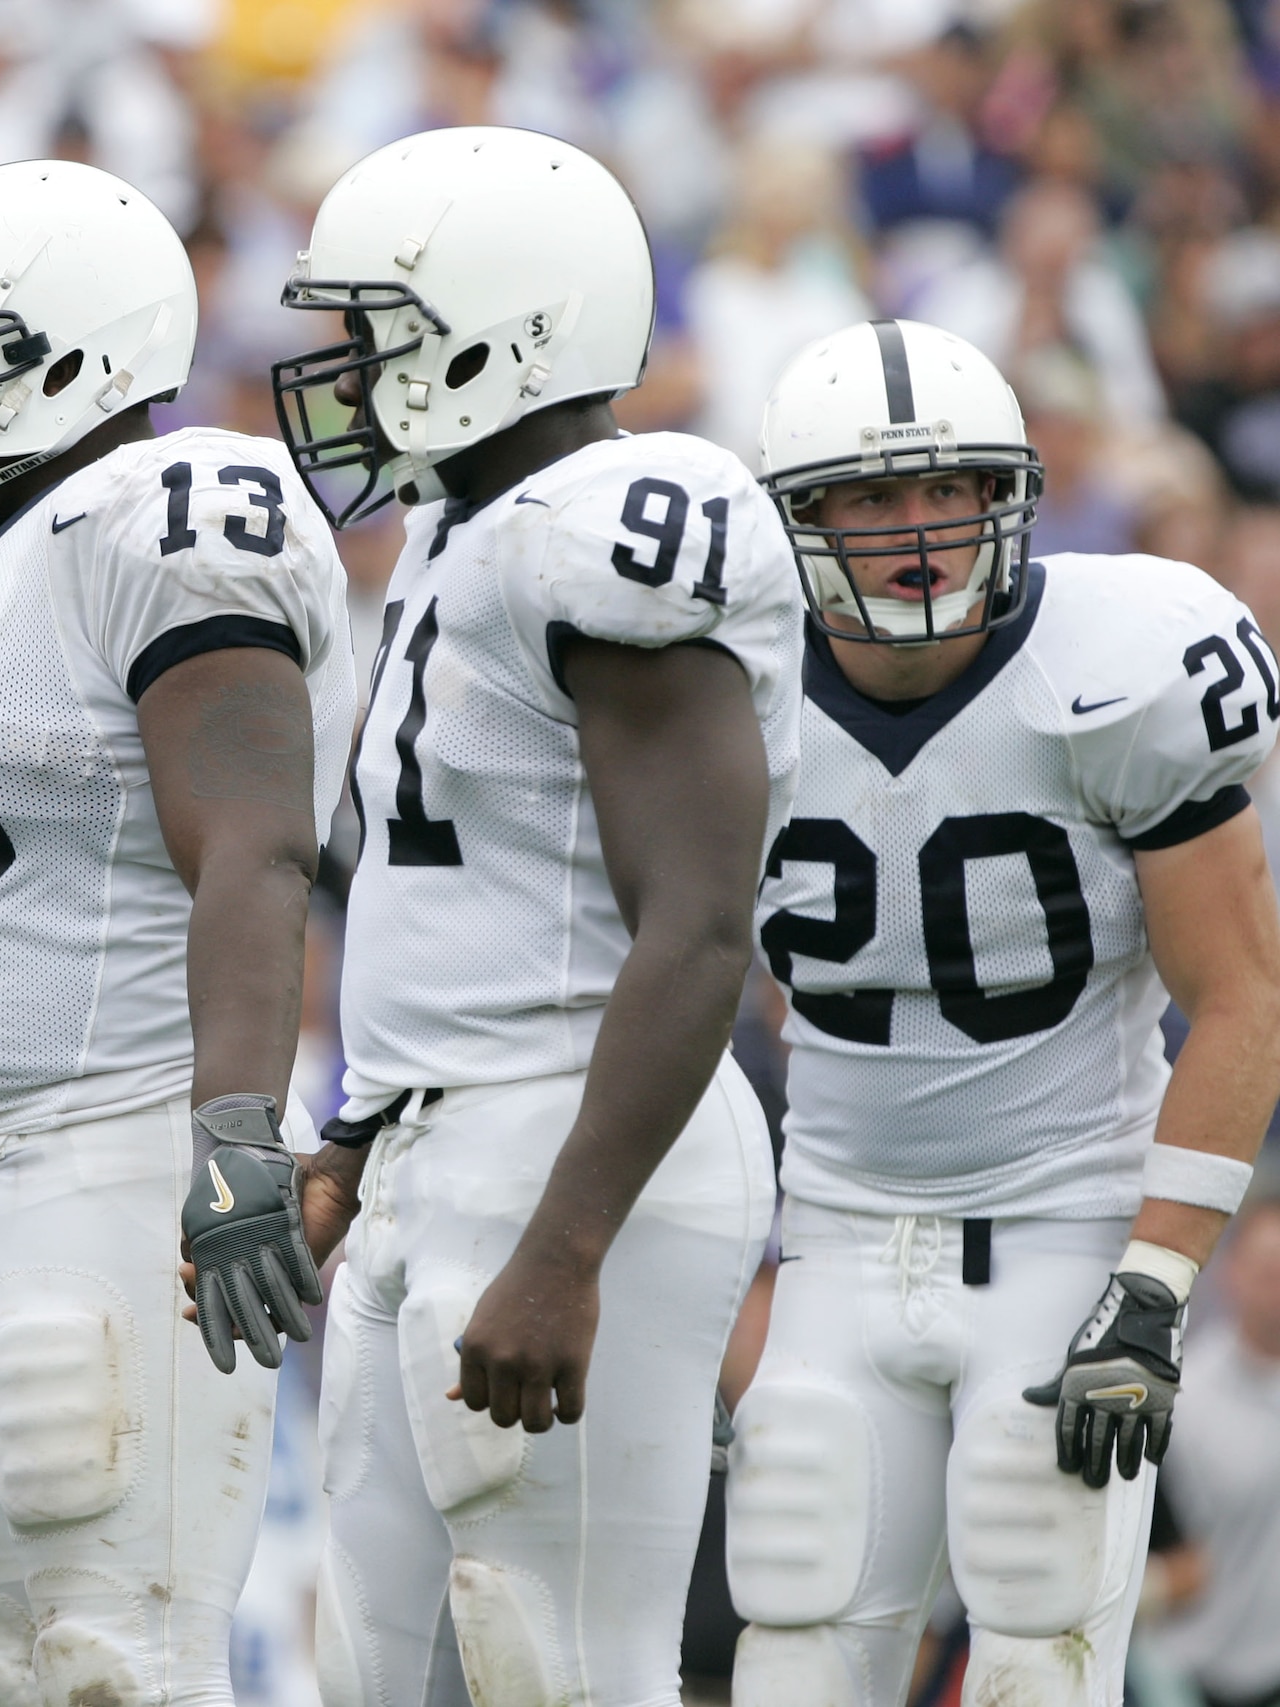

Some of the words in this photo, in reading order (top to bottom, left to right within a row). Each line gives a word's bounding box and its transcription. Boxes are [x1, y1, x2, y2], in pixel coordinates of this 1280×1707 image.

[881, 429, 904, 440] PENN
[905, 427, 931, 437] STATE
[159, 461, 287, 558] 13
[611, 477, 730, 605] 91
[756, 811, 1094, 1047] 20
